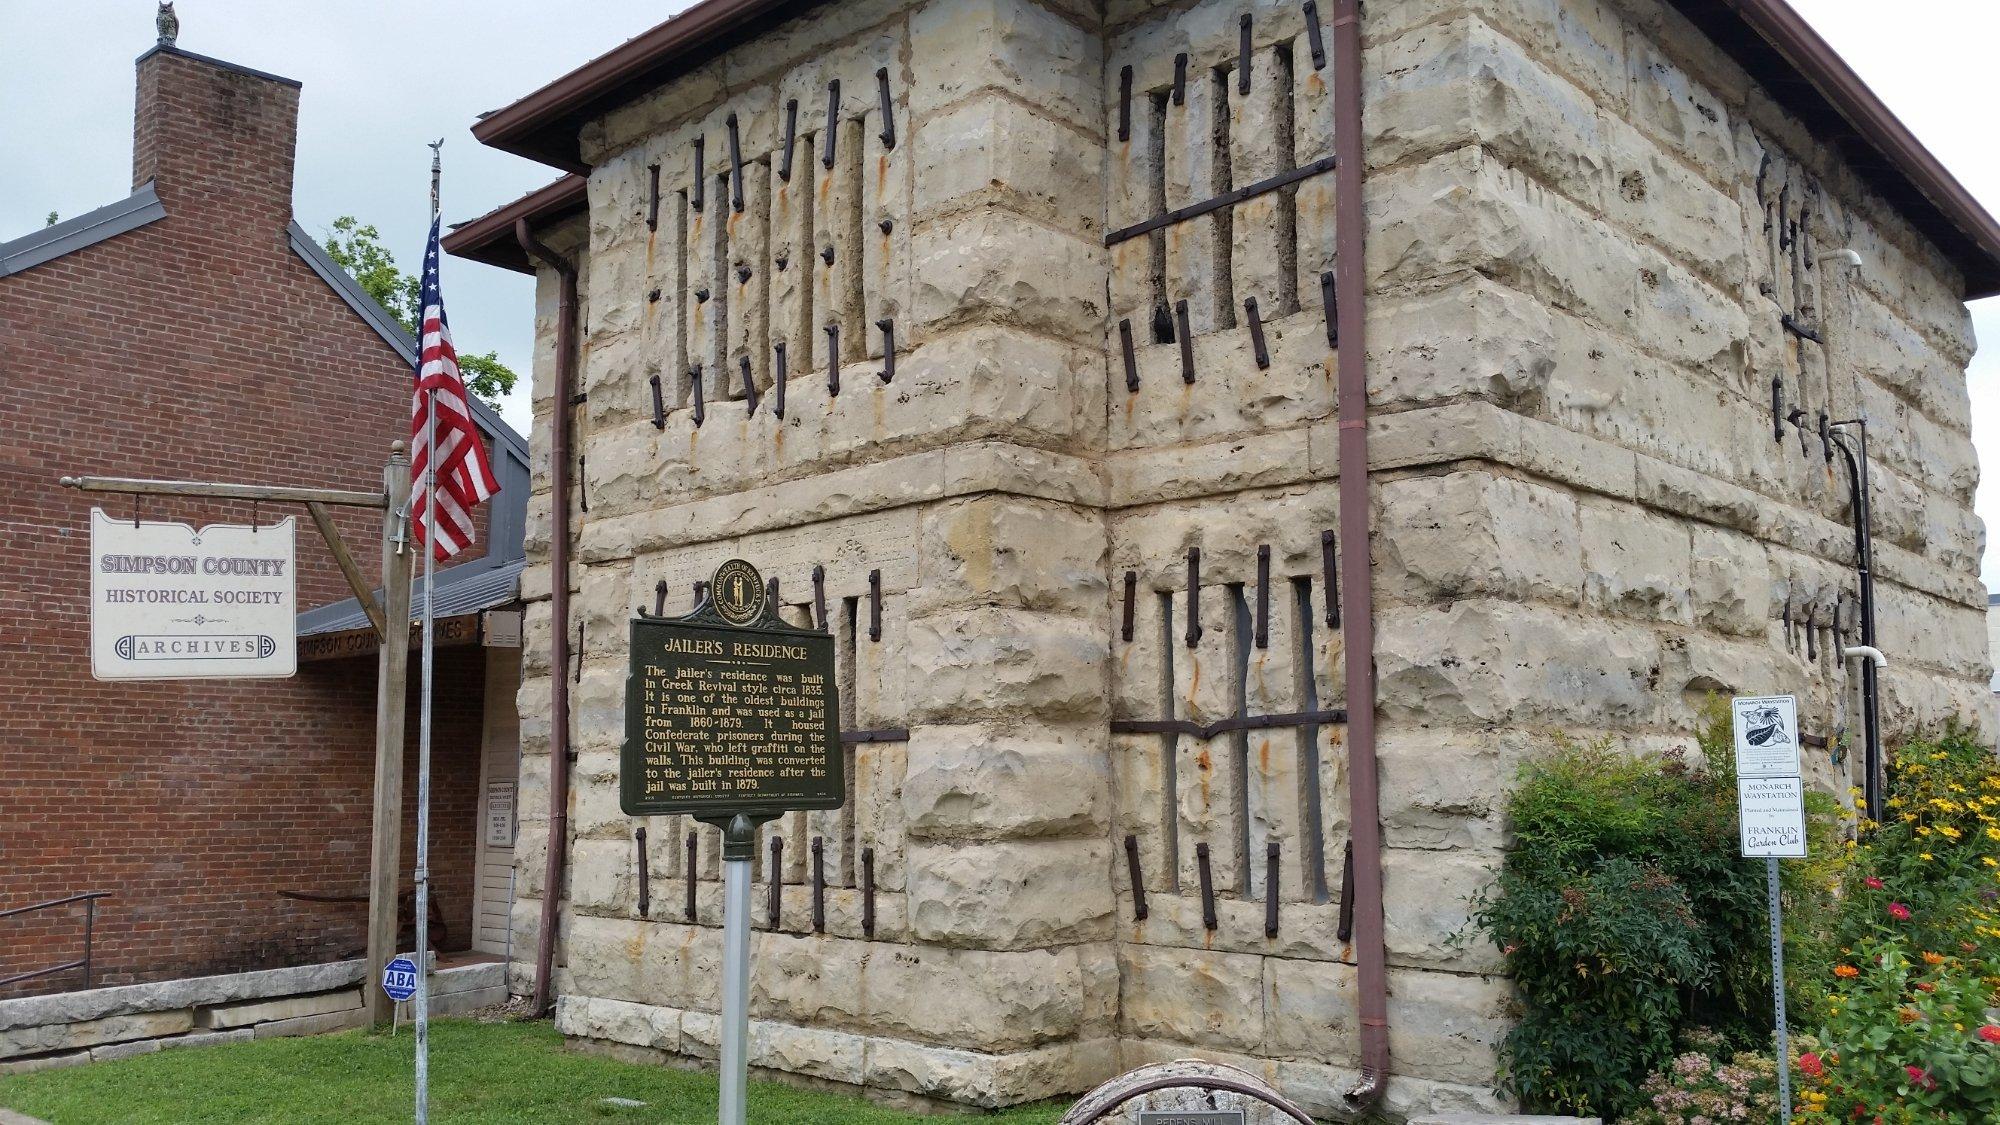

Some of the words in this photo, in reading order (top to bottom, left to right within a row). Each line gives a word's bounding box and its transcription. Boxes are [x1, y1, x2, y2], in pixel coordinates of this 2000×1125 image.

[101, 554, 197, 574] SIMPSON
[202, 557, 286, 576] COUNTY
[716, 564, 740, 604] COMMONWEALTH
[747, 568, 761, 604] KENTUCKY
[106, 589, 208, 603] HISTORICAL
[214, 591, 282, 604] SOCIETY
[138, 641, 255, 654] ARCHIVES
[664, 638, 723, 655] JAILER'S
[734, 643, 807, 660] RESIDENCE
[645, 666, 666, 676] The
[677, 667, 712, 679] jailer's
[721, 671, 767, 682] residence
[801, 674, 824, 684] built
[645, 678, 656, 689] in
[662, 679, 692, 690] Greek
[699, 680, 736, 692] Revival
[742, 683, 768, 695] style
[773, 685, 796, 694] circa
[802, 685, 824, 695] 1835.
[645, 692, 654, 702] It
[662, 693, 670, 702] is
[678, 695, 696, 703] one
[703, 694, 714, 703] of
[722, 694, 738, 704] the
[745, 695, 774, 705] oldest
[781, 696, 824, 708] buildings
[645, 705, 655, 714] in
[661, 705, 706, 715] Franklin
[712, 706, 730, 716] and
[758, 708, 779, 718] used
[809, 709, 824, 720] jail
[645, 717, 672, 727] from
[691, 718, 744, 728] 1860-1879.
[764, 719, 773, 728] It
[792, 720, 824, 730] housed
[645, 729, 709, 740] Confederate
[717, 731, 764, 742] prisoners
[771, 731, 803, 743] during
[810, 733, 825, 742] the
[645, 742, 670, 752] Civil
[676, 742, 698, 754] War,
[703, 744, 723, 753] who
[728, 744, 746, 753] left
[751, 744, 788, 756] graffiti
[810, 744, 825, 754] the
[646, 755, 674, 765] walls.
[680, 755, 703, 765] This
[708, 756, 750, 767] building
[756, 757, 772, 765] was
[778, 756, 825, 765] converted
[646, 768, 657, 778] to
[664, 768, 681, 778] the
[688, 767, 722, 780] jailer's
[728, 767, 774, 777] residence
[780, 767, 804, 777] after
[811, 767, 826, 777] the
[646, 781, 664, 793] jail
[669, 782, 686, 790] was
[692, 780, 716, 790] built
[722, 780, 732, 790] in
[736, 780, 759, 790] 1879.
[1748, 837, 1776, 848] Garden
[1780, 835, 1798, 846] Club
[385, 972, 415, 987] ABA
